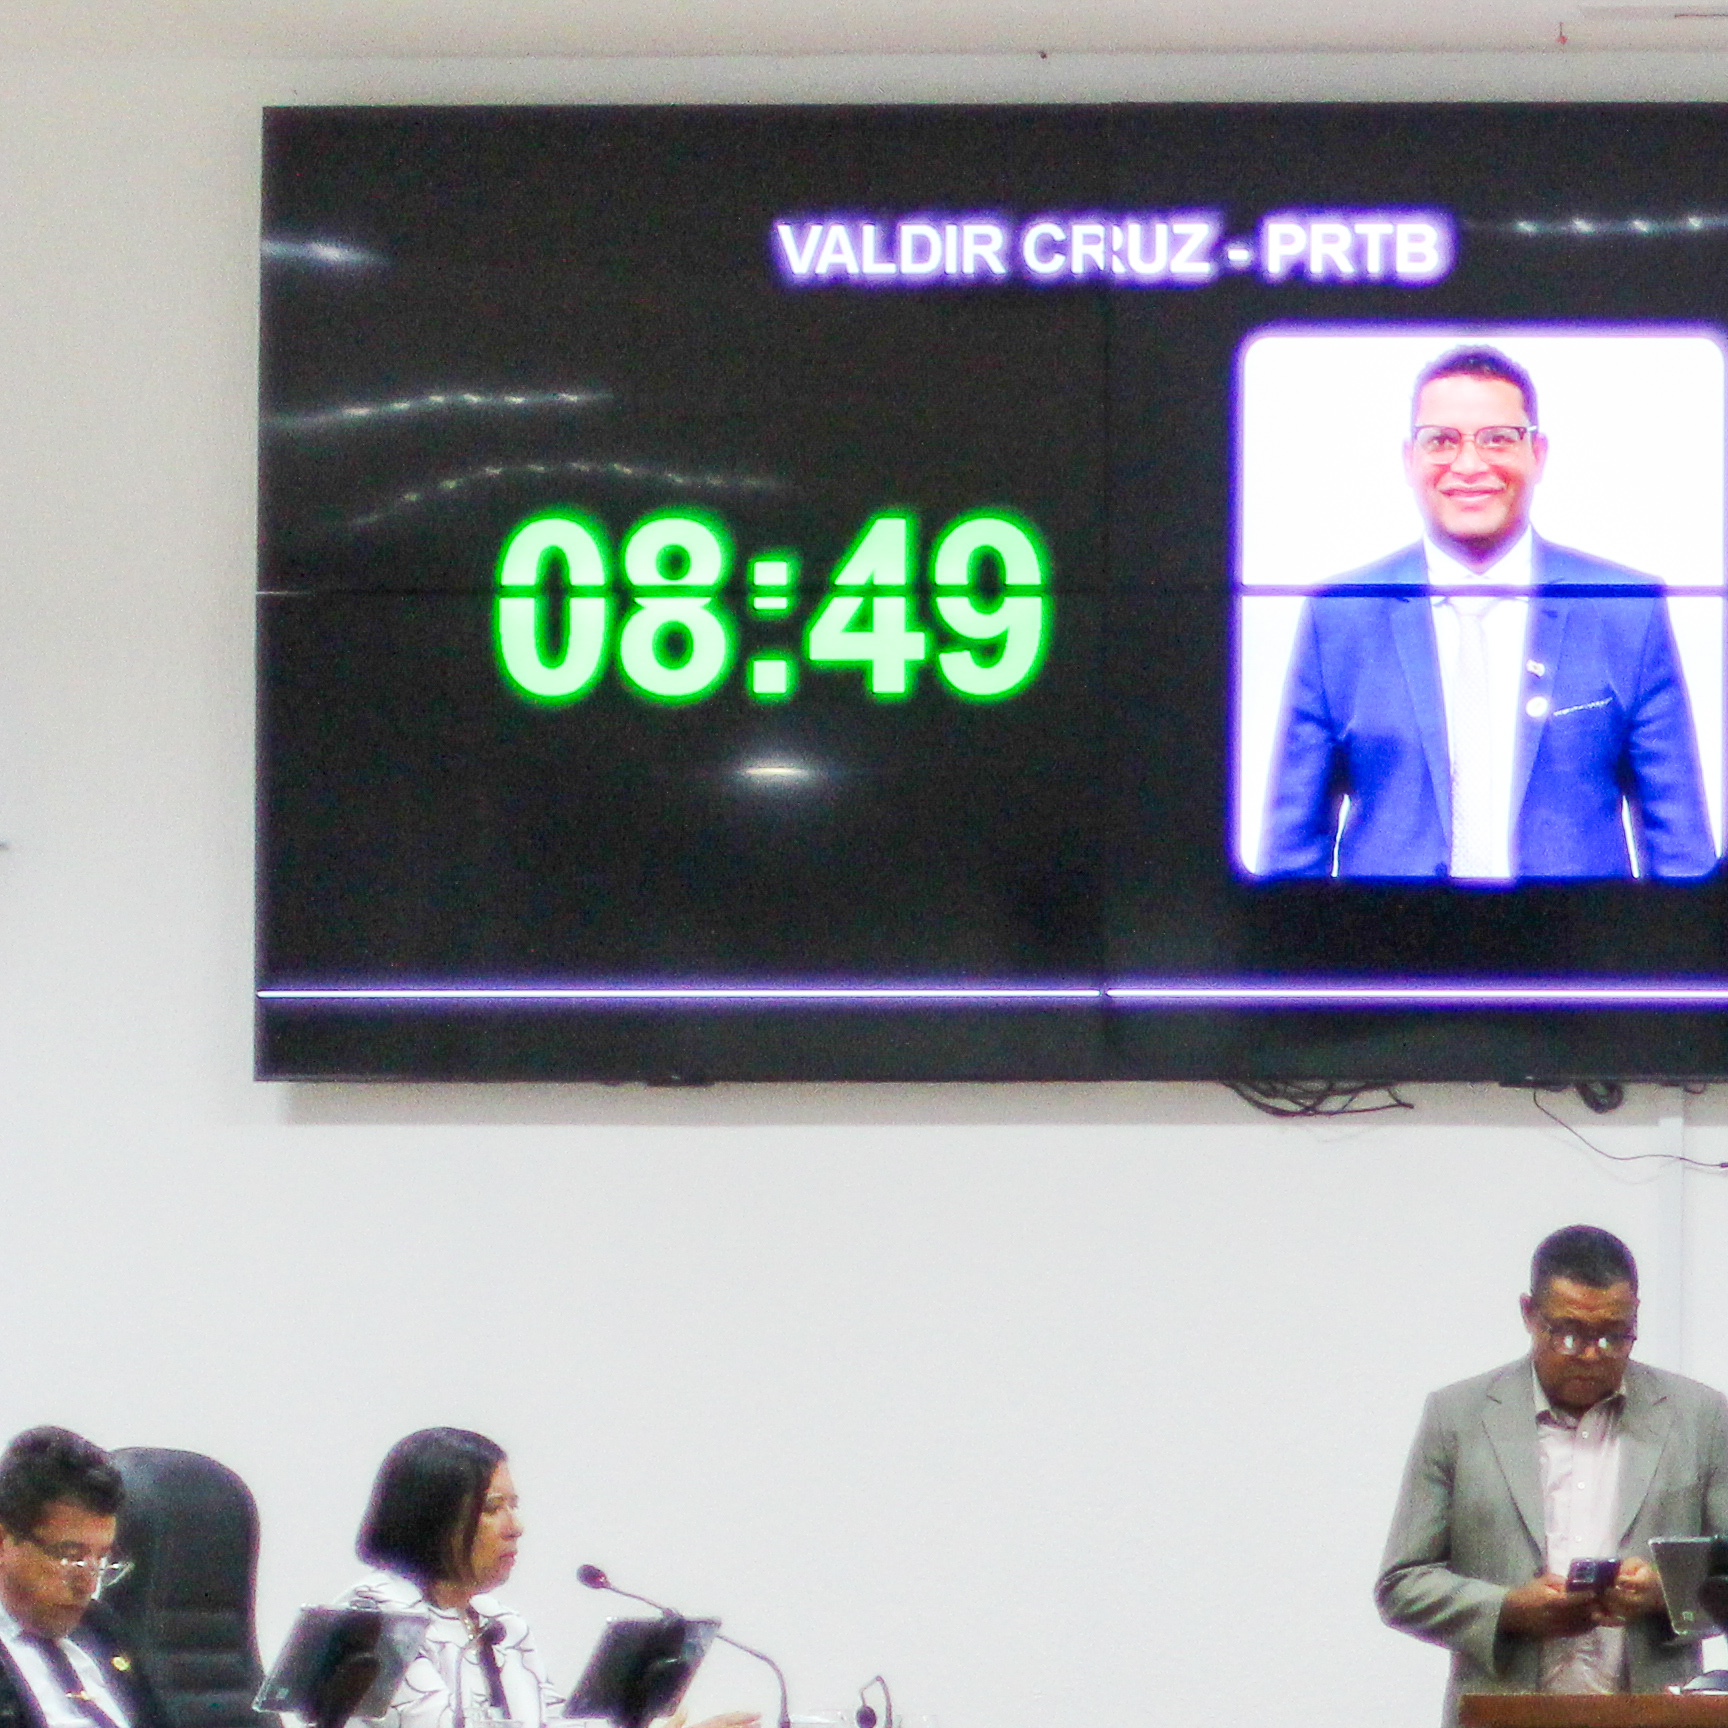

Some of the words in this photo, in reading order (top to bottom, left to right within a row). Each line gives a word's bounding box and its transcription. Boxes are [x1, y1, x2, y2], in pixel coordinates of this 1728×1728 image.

[776, 222, 1008, 276] VALDIR
[1022, 222, 1212, 276] CRUZ
[1267, 222, 1440, 275] PRTB
[497, 515, 1045, 699] 08:49
